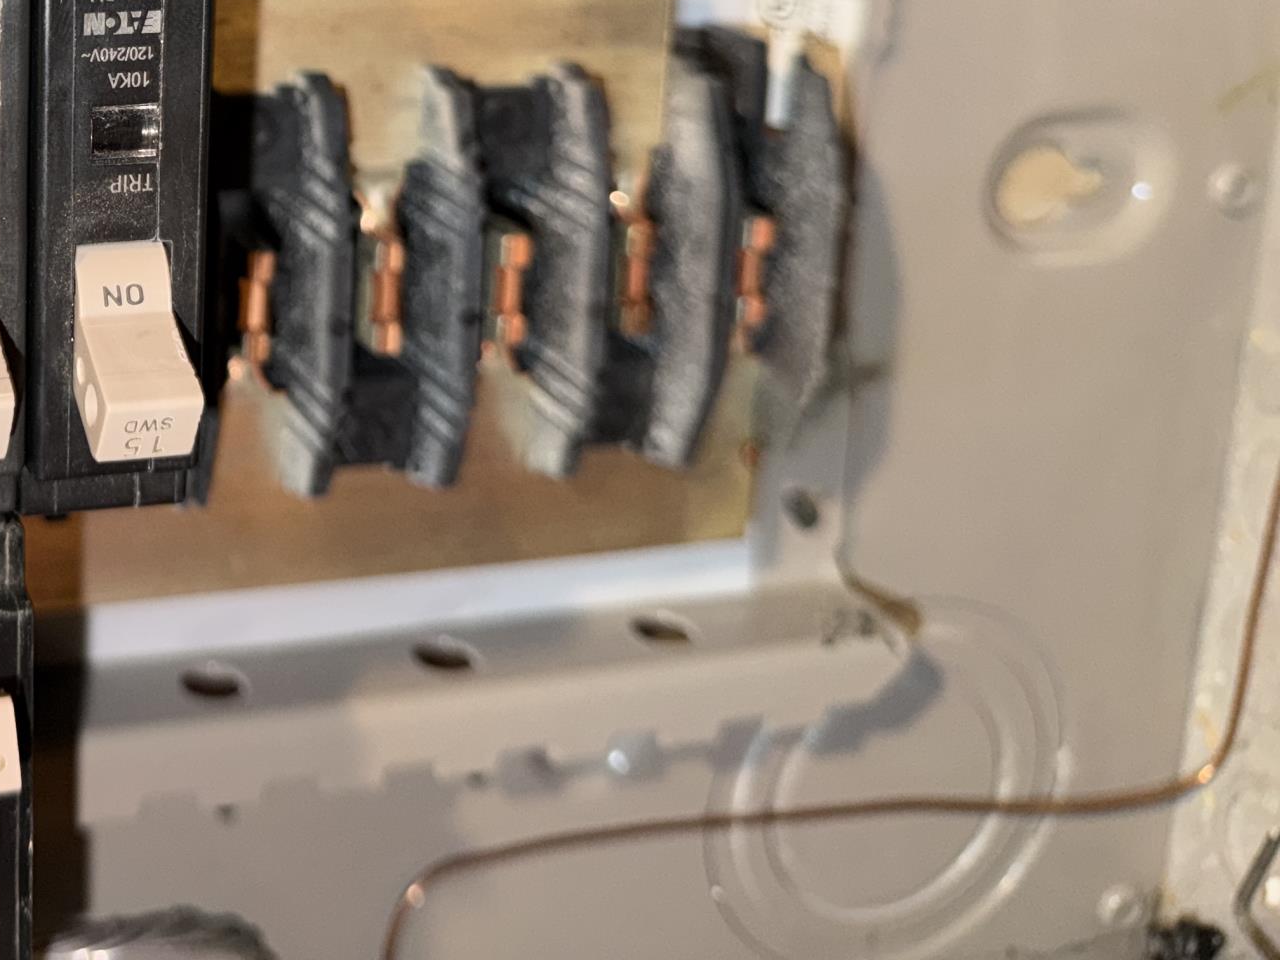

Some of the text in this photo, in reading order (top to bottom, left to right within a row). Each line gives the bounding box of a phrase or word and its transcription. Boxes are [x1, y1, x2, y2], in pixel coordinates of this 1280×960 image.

[83, 10, 162, 37] EATON
[81, 46, 154, 63] 120/240V~
[108, 71, 150, 89] 10KA
[110, 173, 153, 194] TRIP
[101, 282, 145, 308] ON
[124, 417, 174, 434] SWD
[124, 436, 163, 457] 15
